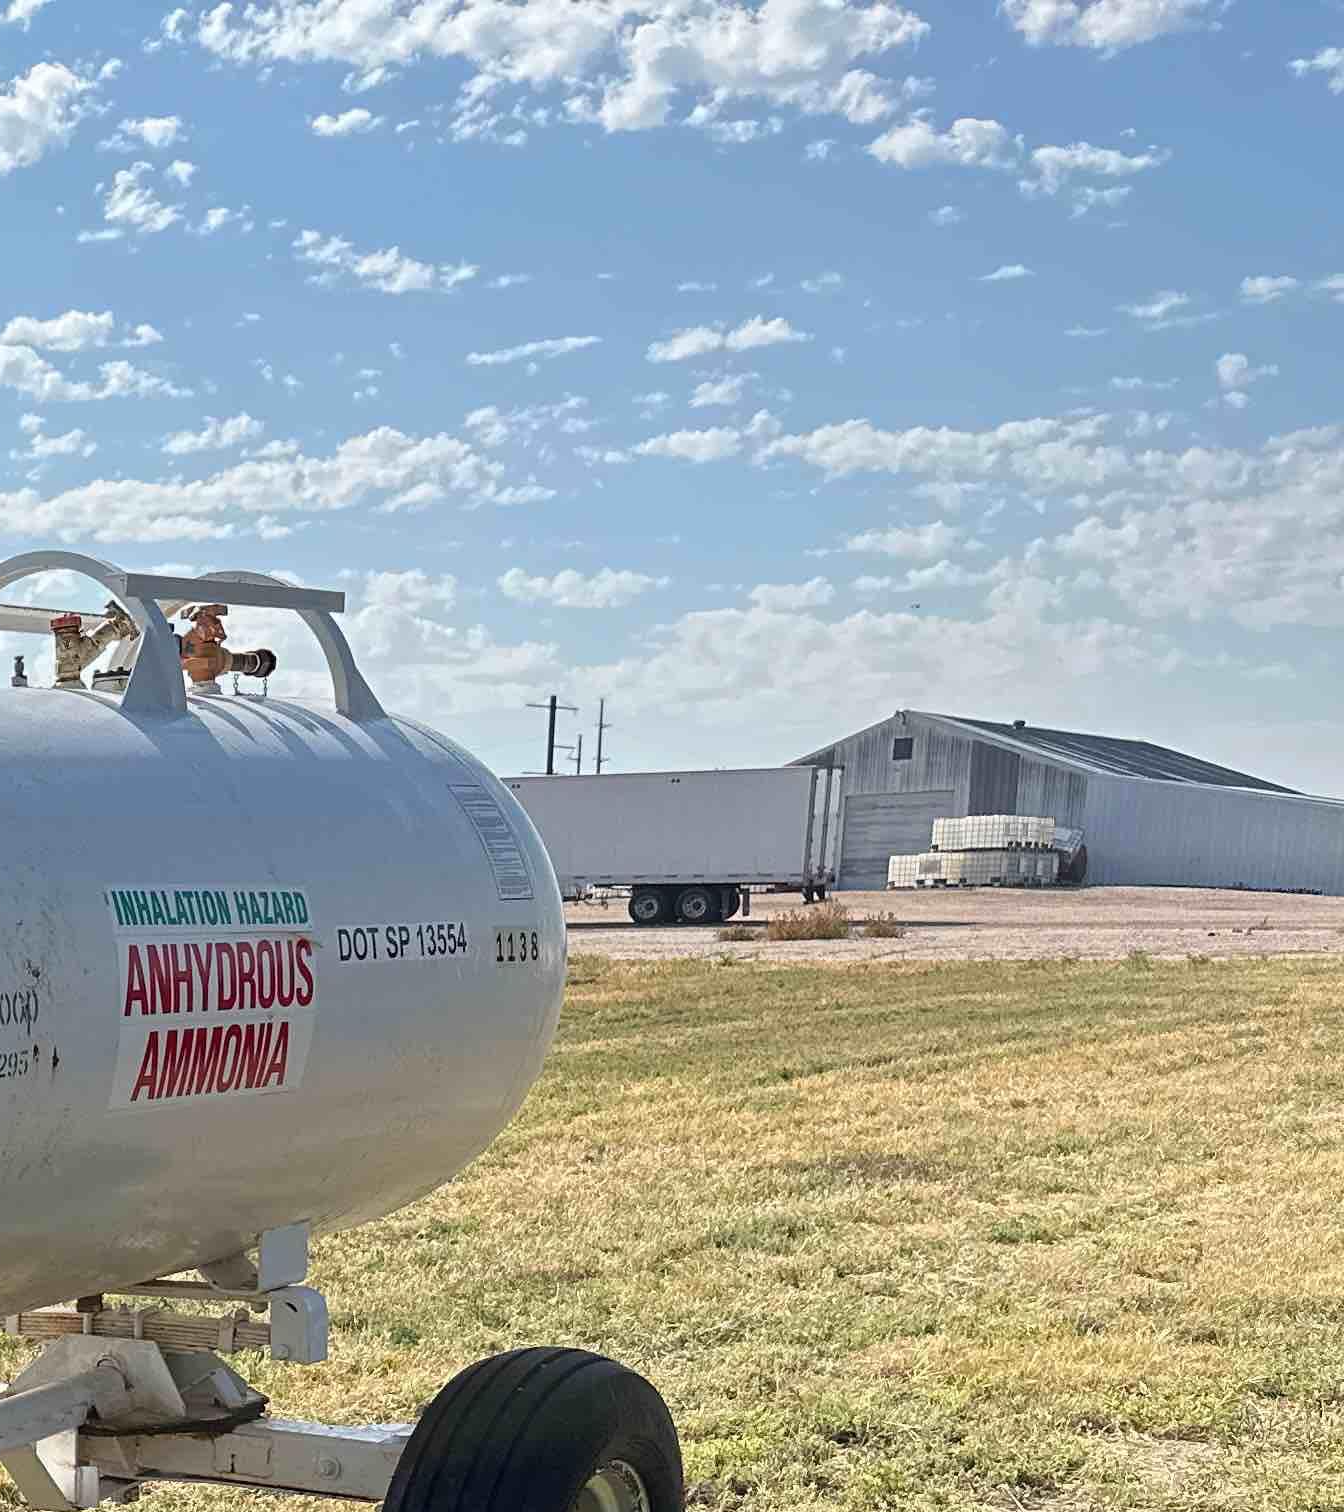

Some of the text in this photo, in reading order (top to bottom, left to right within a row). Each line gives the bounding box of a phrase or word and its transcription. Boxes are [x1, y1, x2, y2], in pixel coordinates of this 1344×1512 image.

[112, 890, 309, 926] INHALATION HAZARD
[338, 922, 468, 961] DOT SP 13554
[496, 931, 539, 962] 1138
[124, 937, 314, 1017] ANHYDROUS
[130, 1021, 289, 1102] AMMONIA
